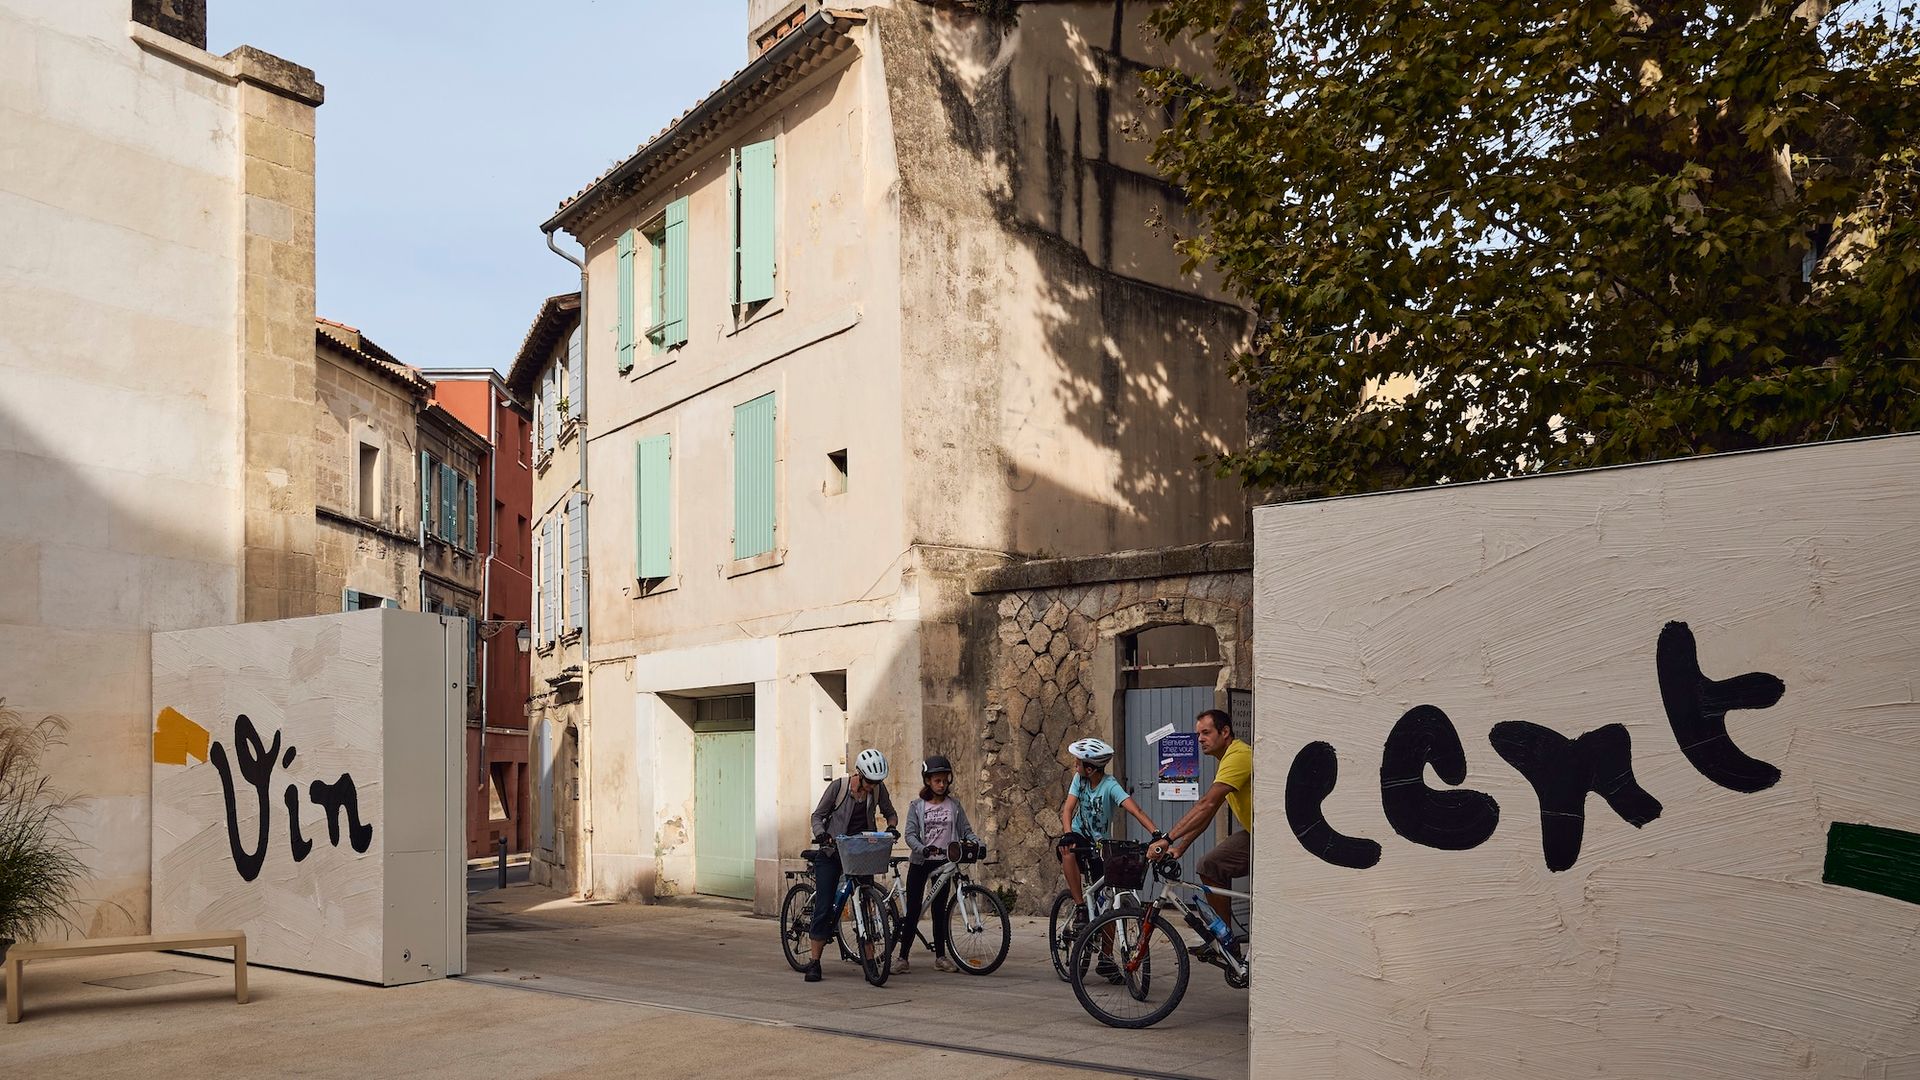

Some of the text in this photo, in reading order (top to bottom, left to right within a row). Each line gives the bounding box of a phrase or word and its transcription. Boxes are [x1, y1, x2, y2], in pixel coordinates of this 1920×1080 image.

[209, 714, 373, 882] Vin
[1162, 738, 1194, 746] Bienvenue
[1285, 620, 1786, 873] cent
